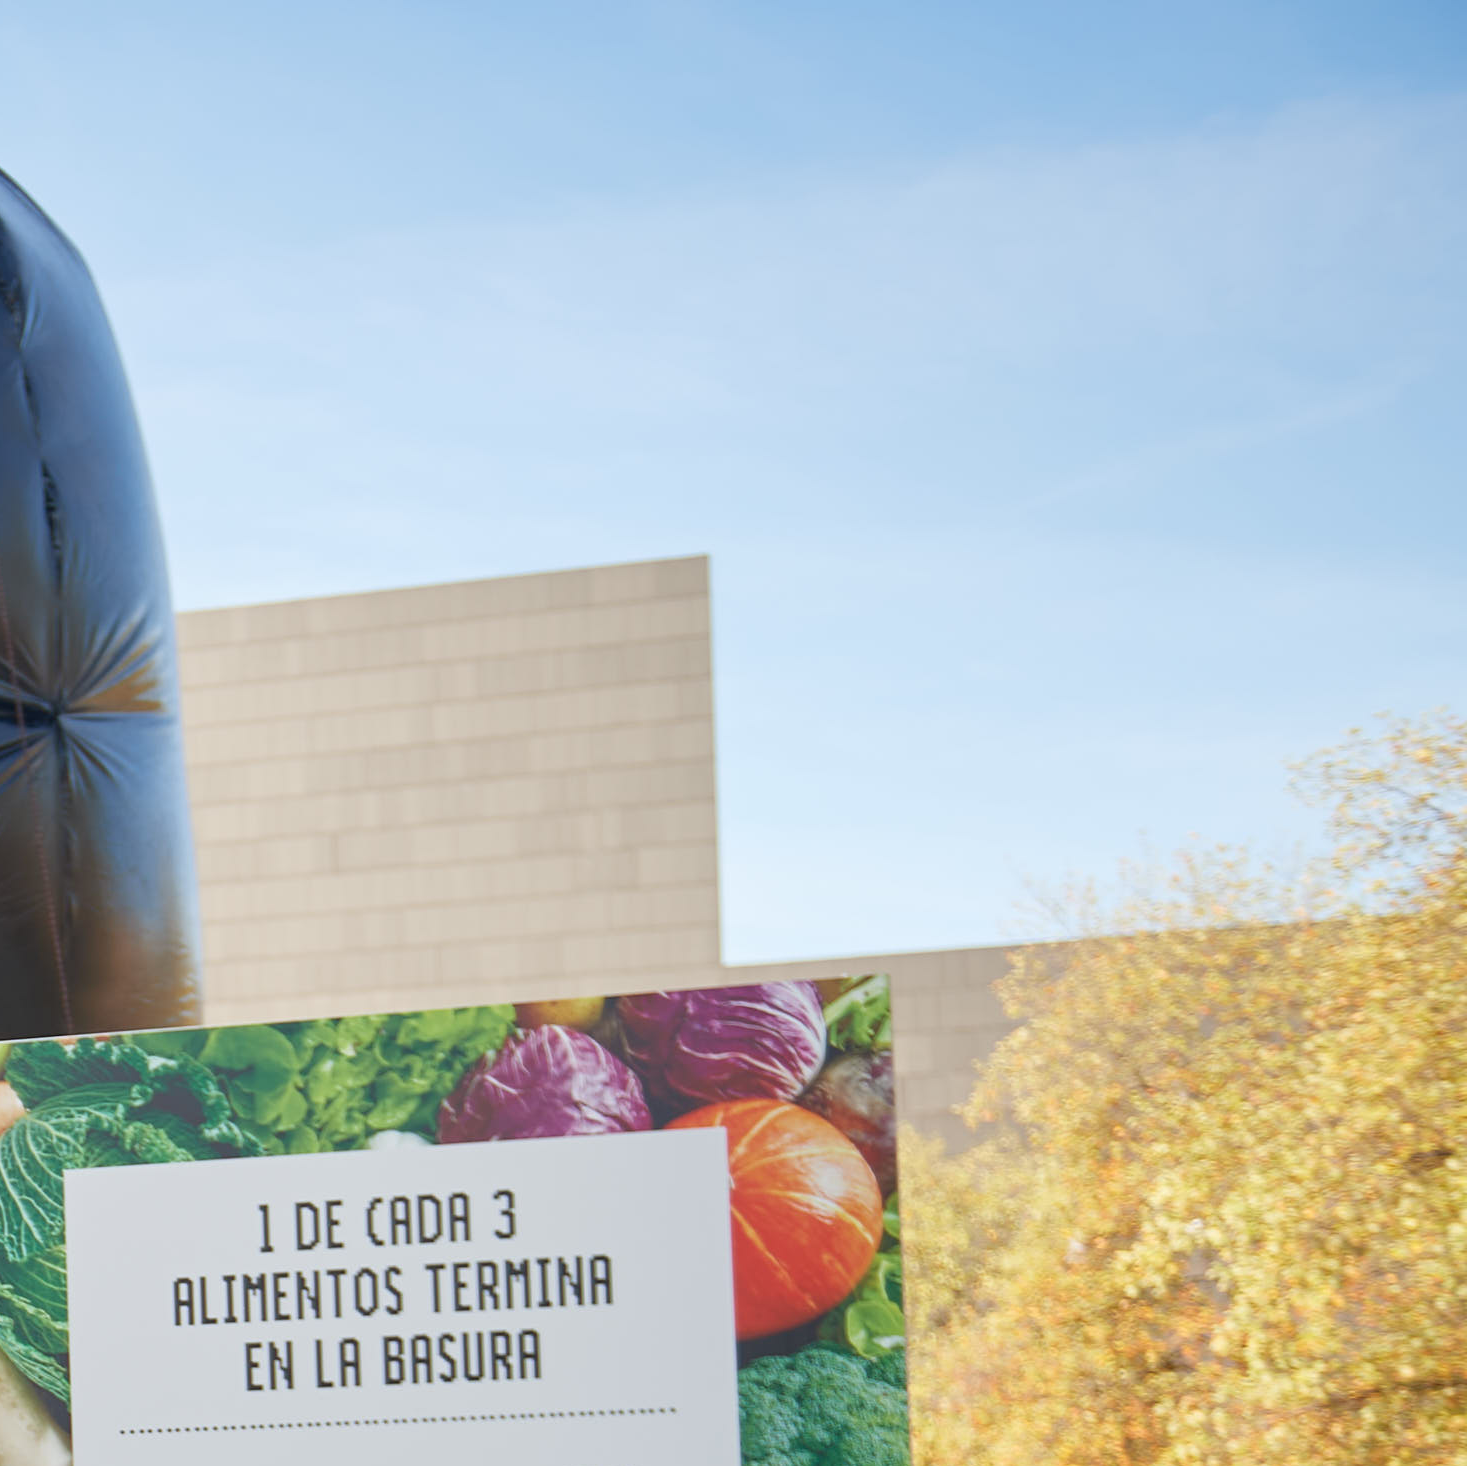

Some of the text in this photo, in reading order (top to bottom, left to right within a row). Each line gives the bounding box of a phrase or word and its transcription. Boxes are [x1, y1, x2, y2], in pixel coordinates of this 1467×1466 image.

[258, 1190, 517, 1253] 1 DE CADA 3
[173, 1254, 614, 1326] ALIMENTOS TERMINA
[245, 1329, 542, 1391] EN LA BASURA
